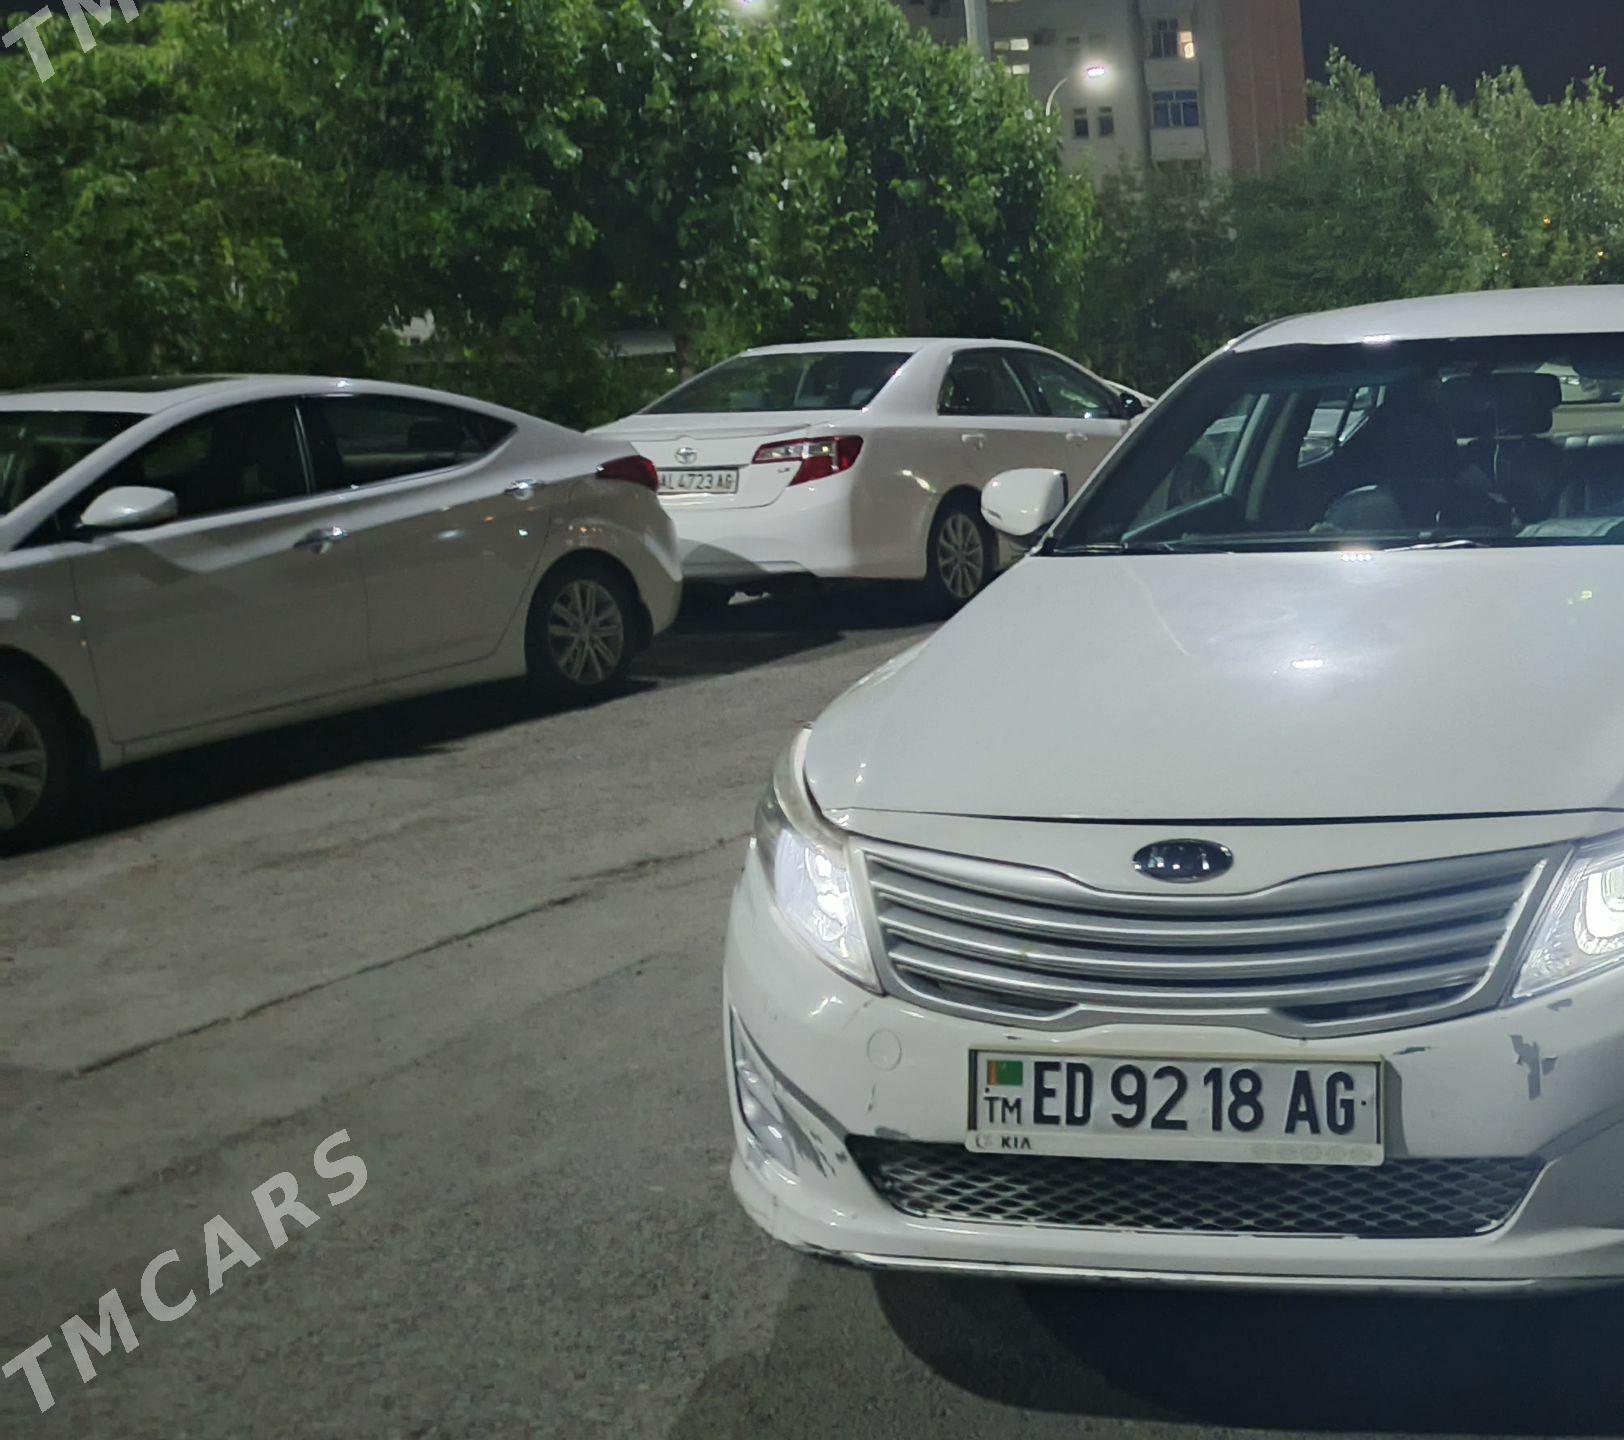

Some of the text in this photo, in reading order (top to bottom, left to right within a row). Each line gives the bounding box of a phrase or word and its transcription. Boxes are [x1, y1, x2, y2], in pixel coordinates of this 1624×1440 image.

[677, 473, 714, 490] 4723
[1033, 1061, 1355, 1136] ED 92 18 AG
[983, 1096, 1022, 1125] TM
[1001, 1136, 1032, 1150] KIA
